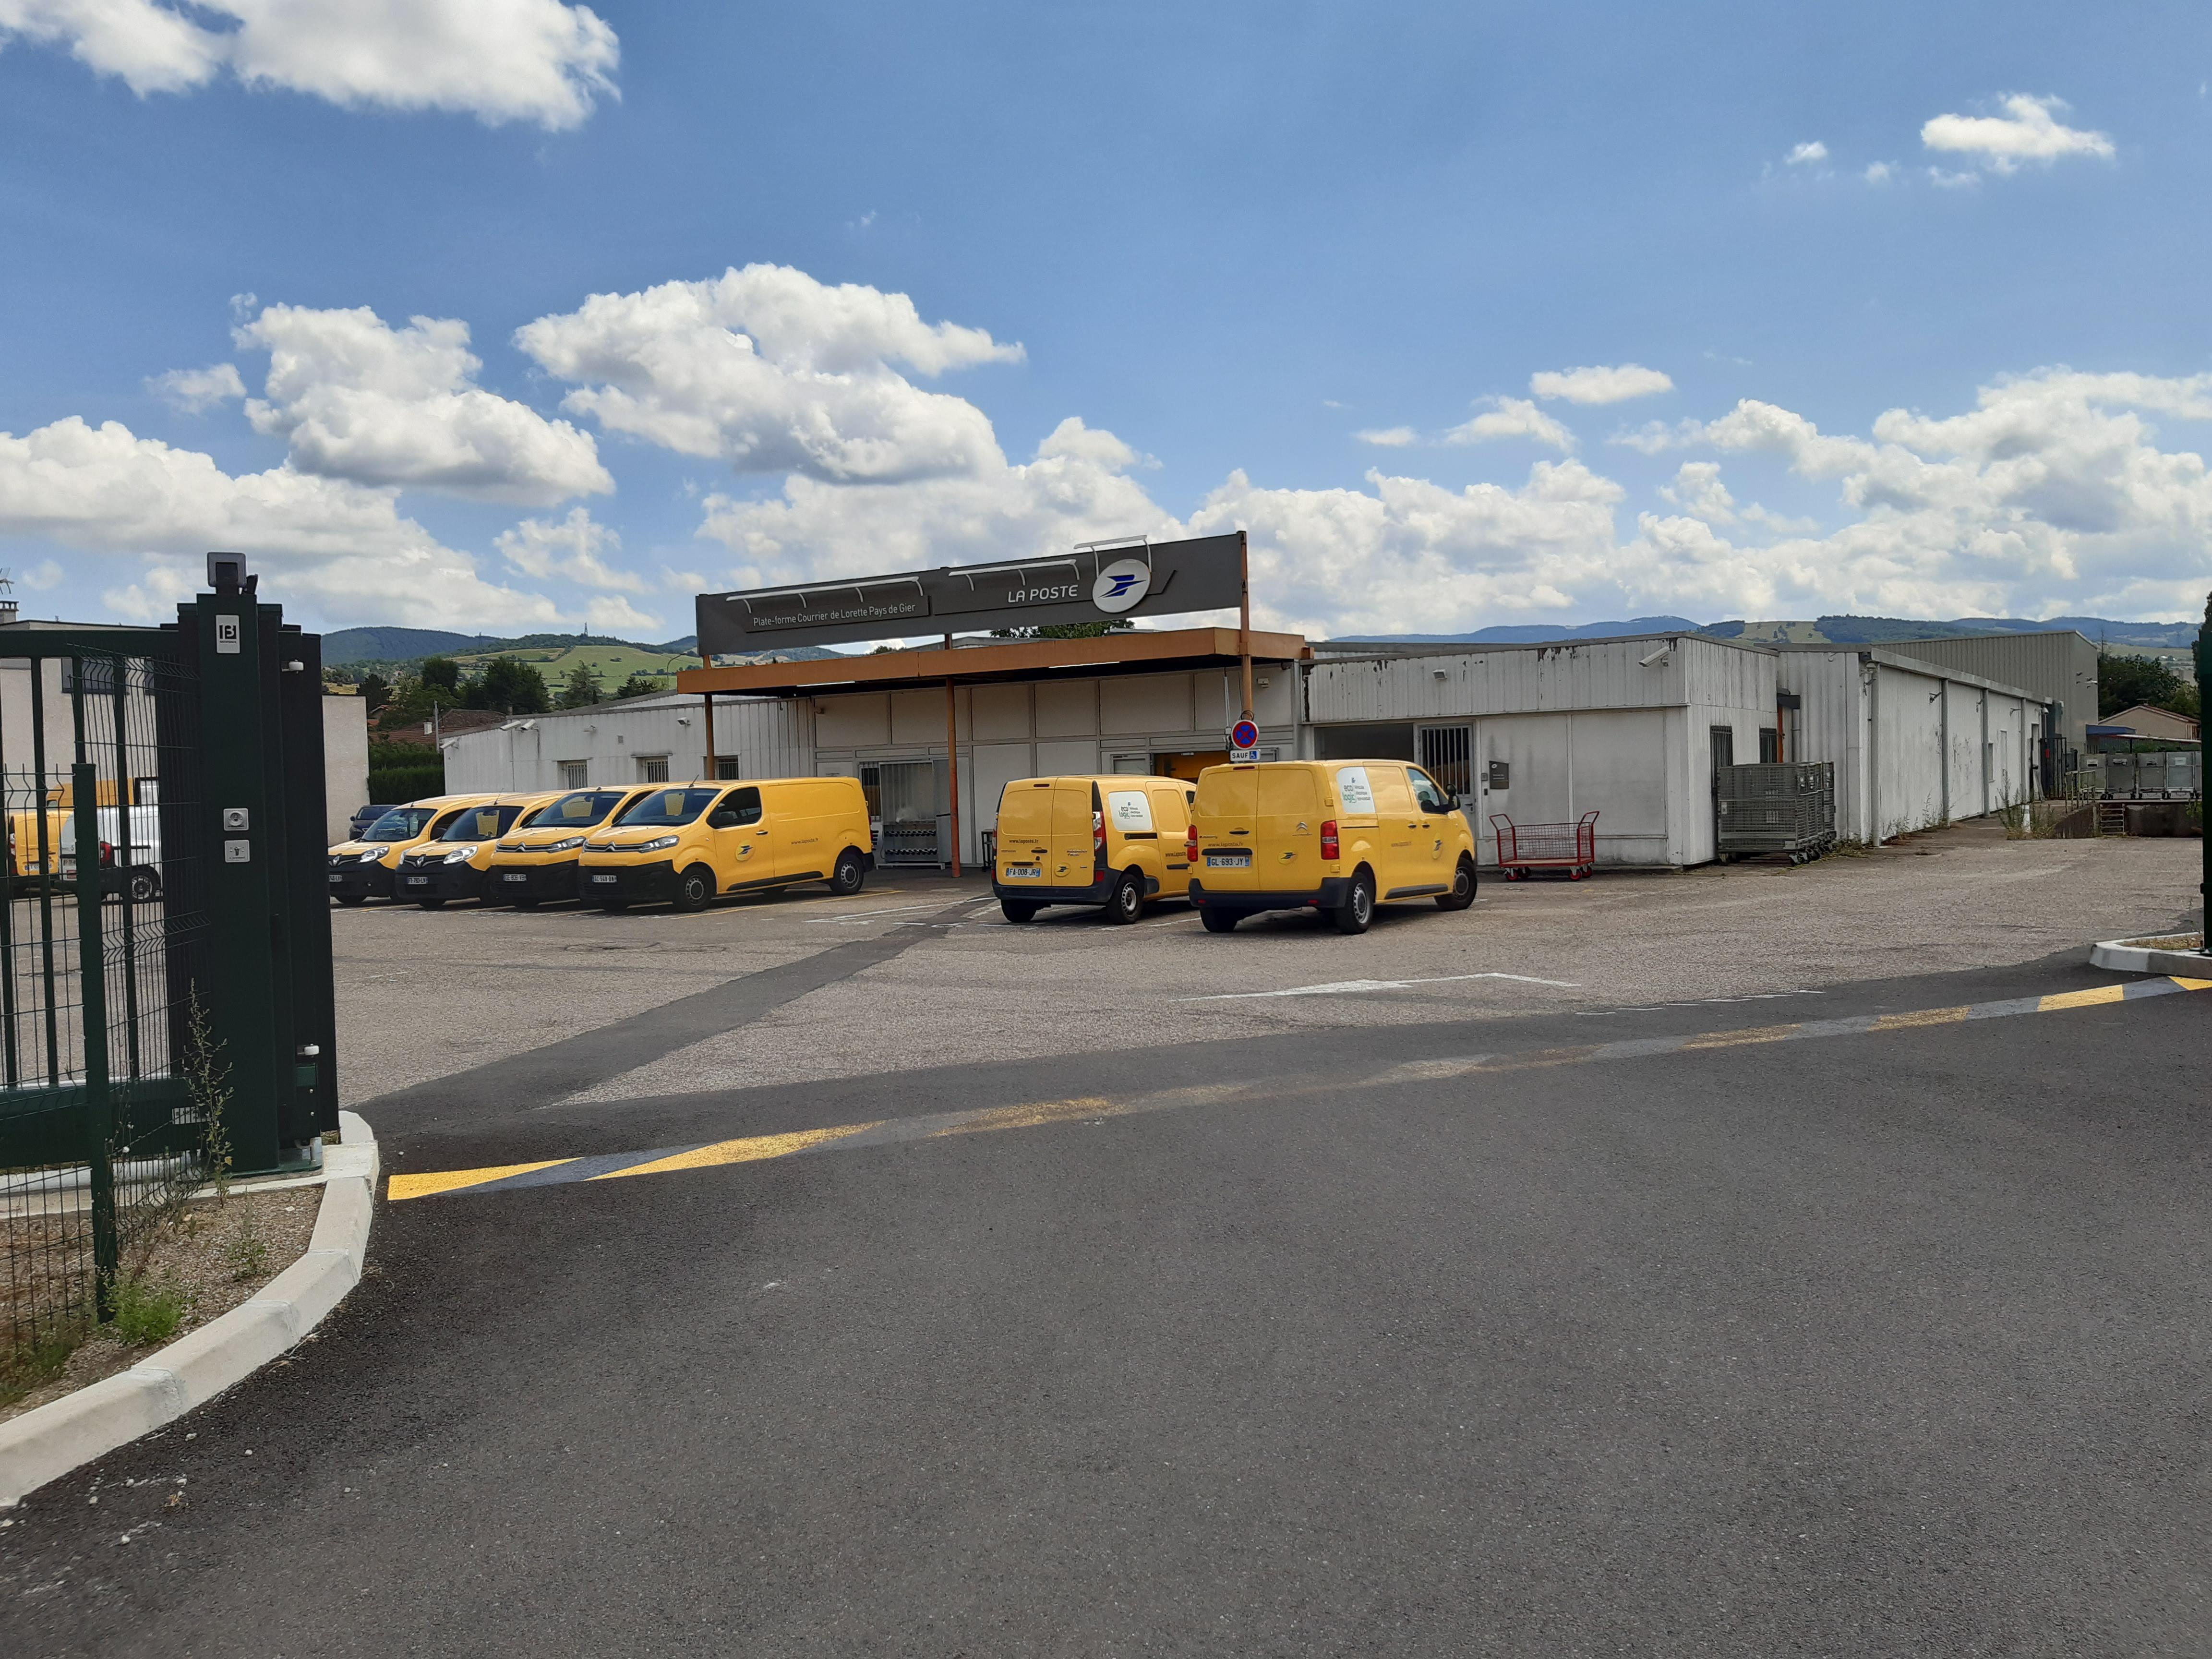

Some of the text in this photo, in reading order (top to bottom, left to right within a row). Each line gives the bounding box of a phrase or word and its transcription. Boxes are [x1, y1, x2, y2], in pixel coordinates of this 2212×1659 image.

[1008, 585, 1078, 602] LA POSTE
[753, 616, 796, 626] Plate-forme
[797, 613, 827, 623] Courrier
[841, 608, 868, 618] Lorette
[869, 607, 887, 616] Pays
[899, 603, 915, 612] Gier
